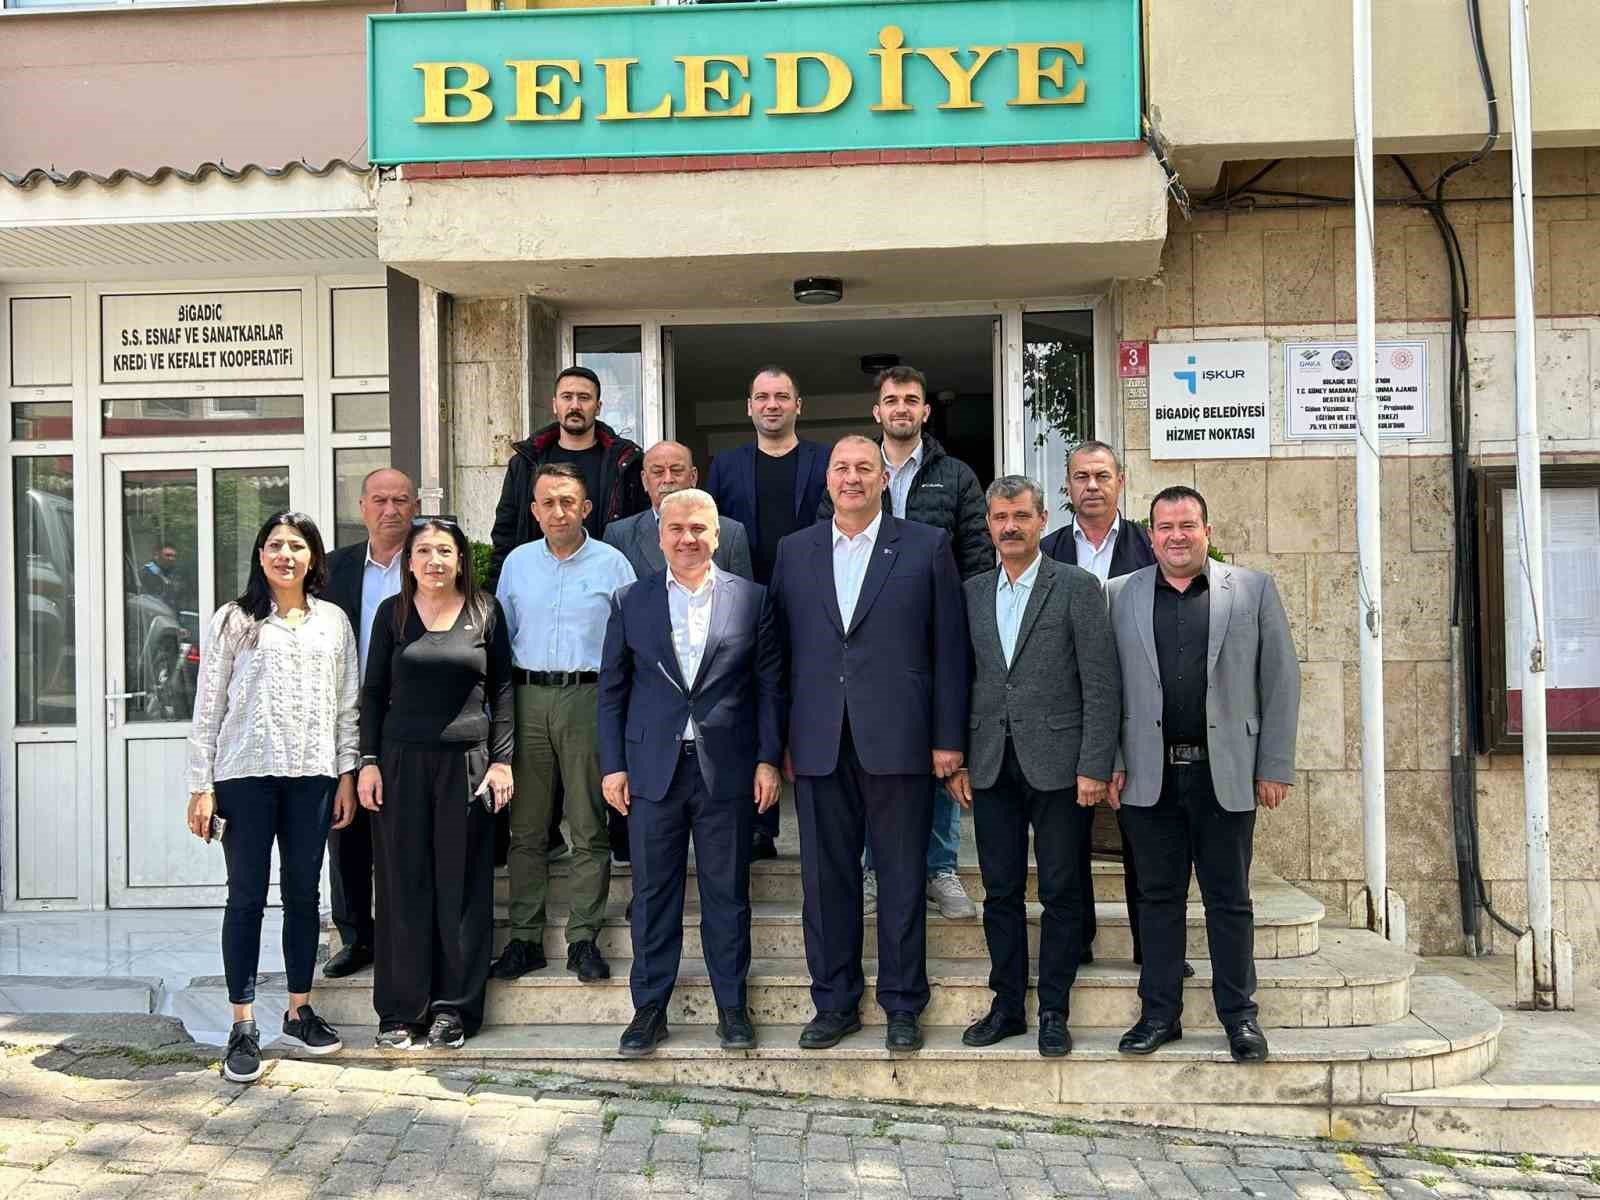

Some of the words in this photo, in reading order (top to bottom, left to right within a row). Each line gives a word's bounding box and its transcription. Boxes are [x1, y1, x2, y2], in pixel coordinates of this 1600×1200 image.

[411, 24, 1086, 124] BELEDİYE
[121, 329, 143, 346] S.S.
[145, 328, 182, 345] ESNAF
[185, 327, 200, 344] VE
[202, 324, 284, 343] SANATKARLAR
[150, 353, 165, 370] VE
[168, 351, 217, 369] KEFALET
[1128, 349, 1138, 366] 3
[1155, 404, 1200, 422] BİGADİÇ
[1203, 403, 1265, 418] BELEDİYESİ
[1166, 426, 1206, 441] HİZMET
[1209, 428, 1255, 440] NOKTASI
